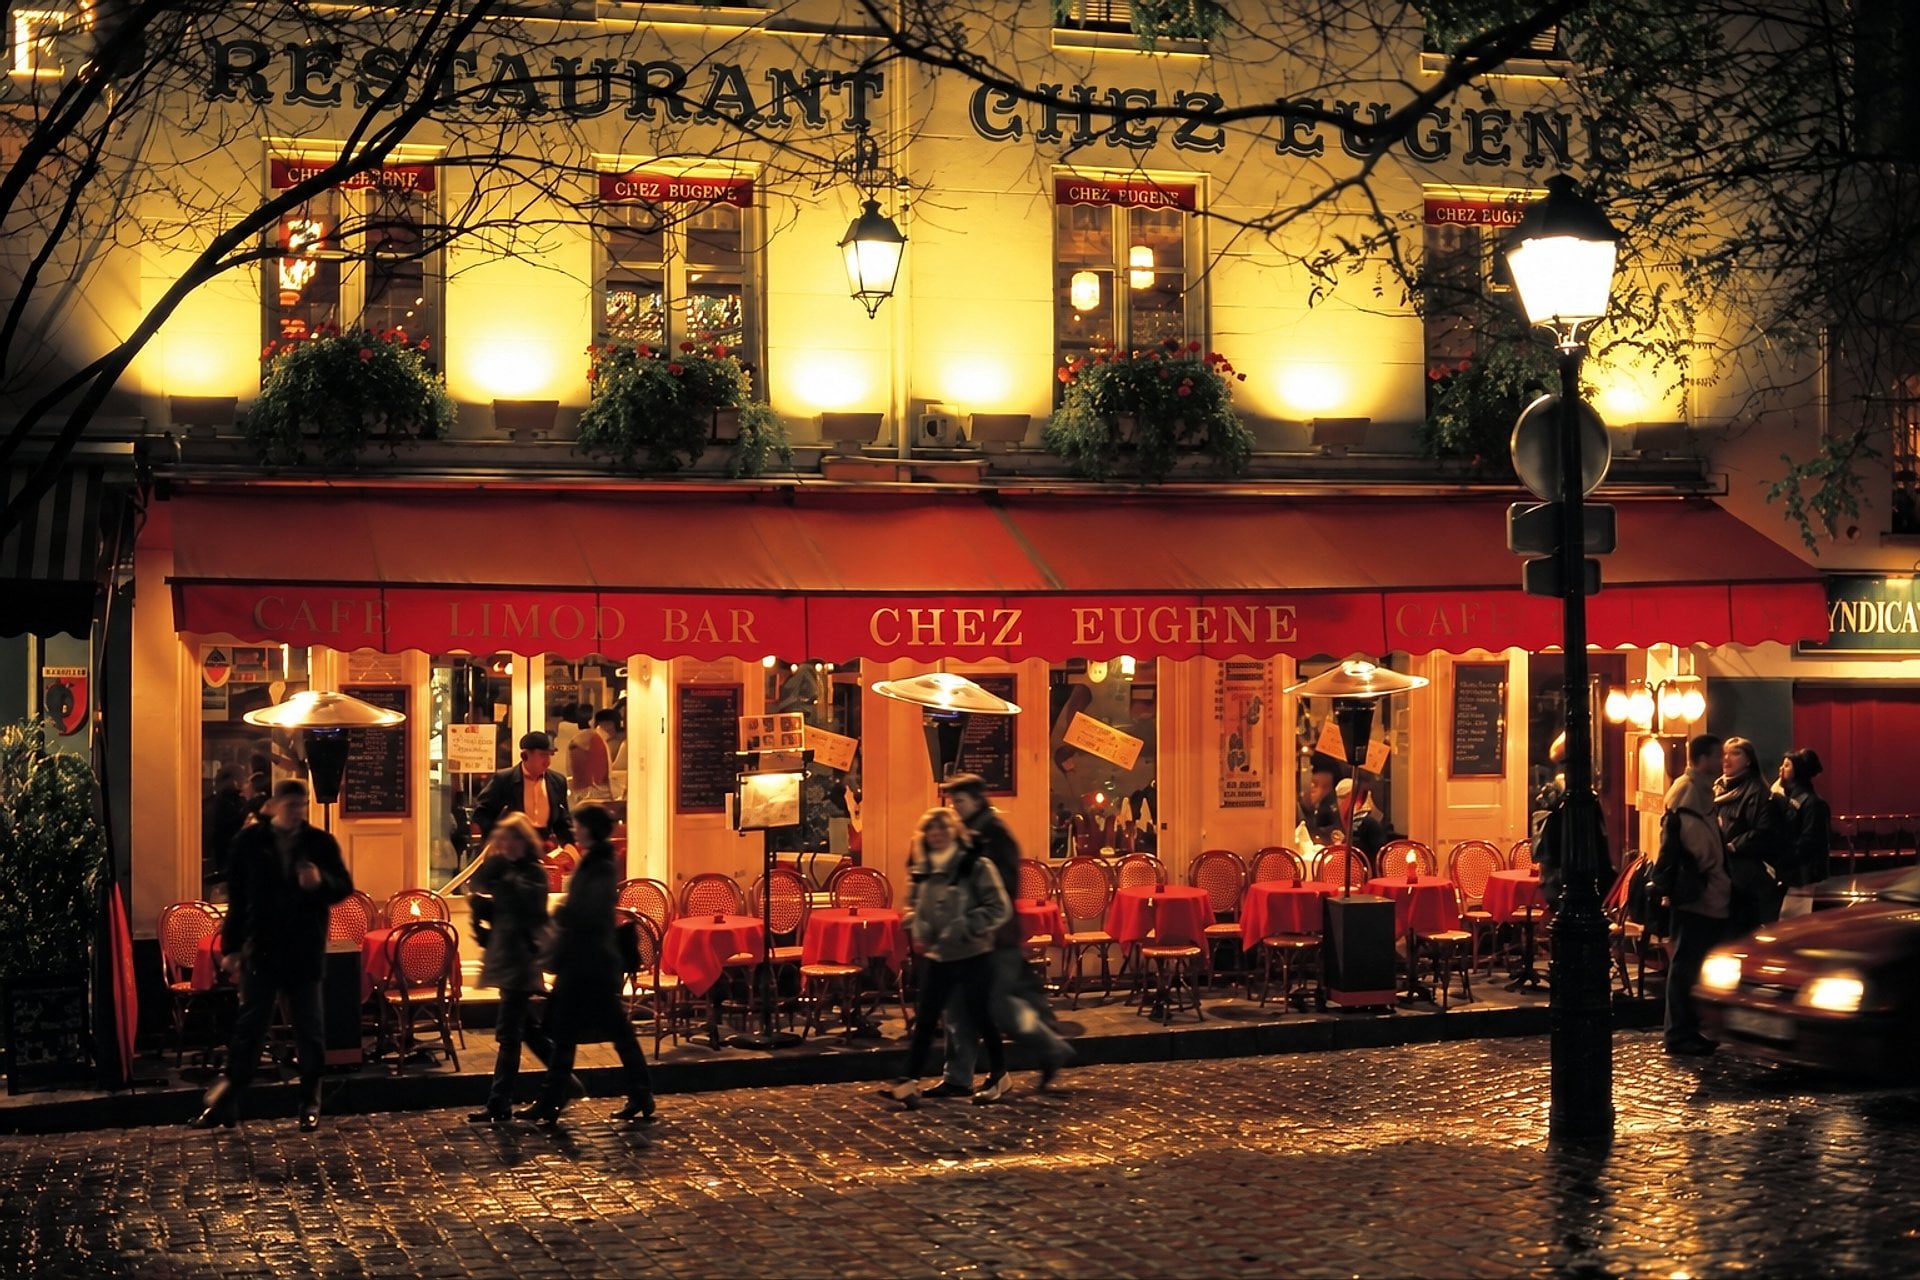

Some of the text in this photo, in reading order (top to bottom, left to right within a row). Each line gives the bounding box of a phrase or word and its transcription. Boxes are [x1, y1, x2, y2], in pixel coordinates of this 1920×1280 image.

[203, 38, 884, 131] RESTAURANT
[969, 83, 1226, 153] CHEZ
[614, 182, 661, 198] CHEZ
[1069, 186, 1179, 206] CHEZ EUGENE
[1436, 207, 1477, 222] CHEZ
[661, 608, 760, 643] BAR
[869, 604, 1298, 647] CHEZ EUGENE
[1827, 599, 1920, 634] YNDICA
